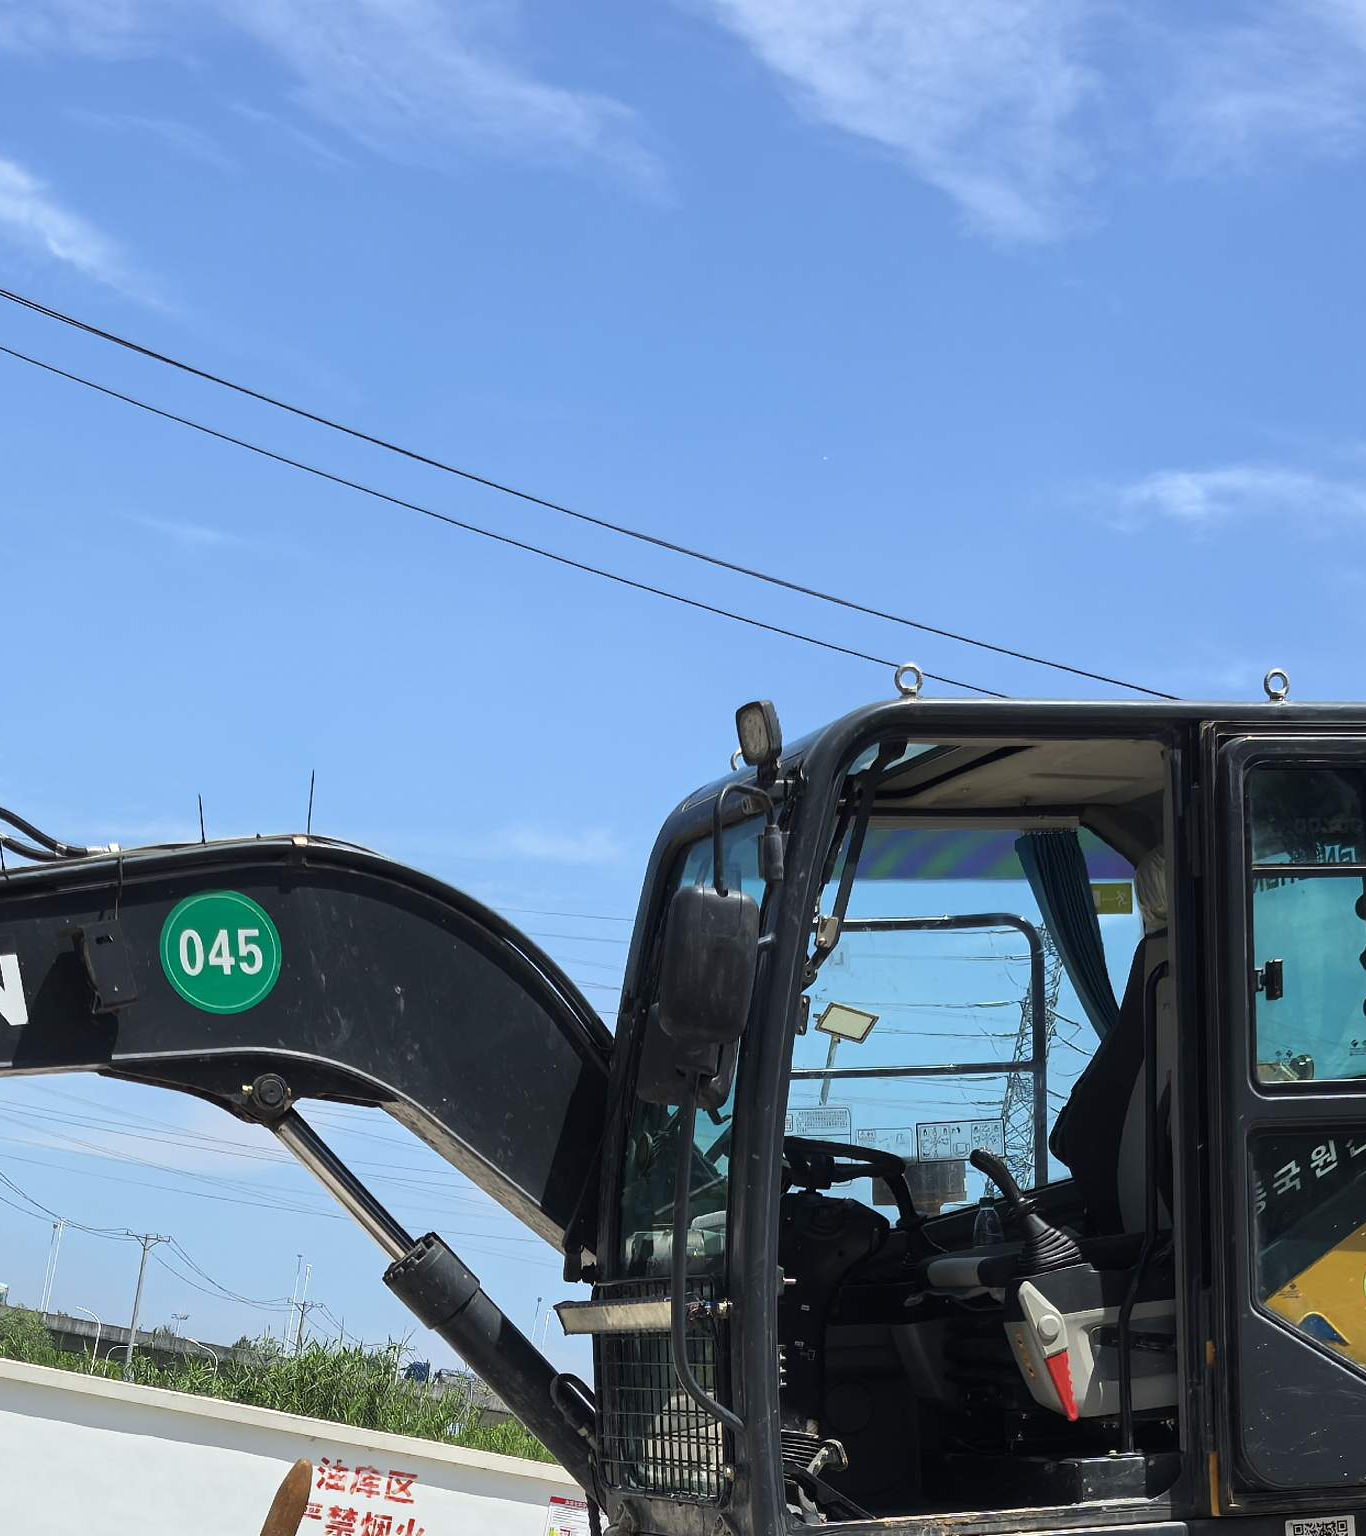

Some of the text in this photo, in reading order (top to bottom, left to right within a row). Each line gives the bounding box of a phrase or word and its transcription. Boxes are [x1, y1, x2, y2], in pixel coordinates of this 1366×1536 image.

[179, 928, 263, 976] 045
[316, 1456, 418, 1504] 油库区
